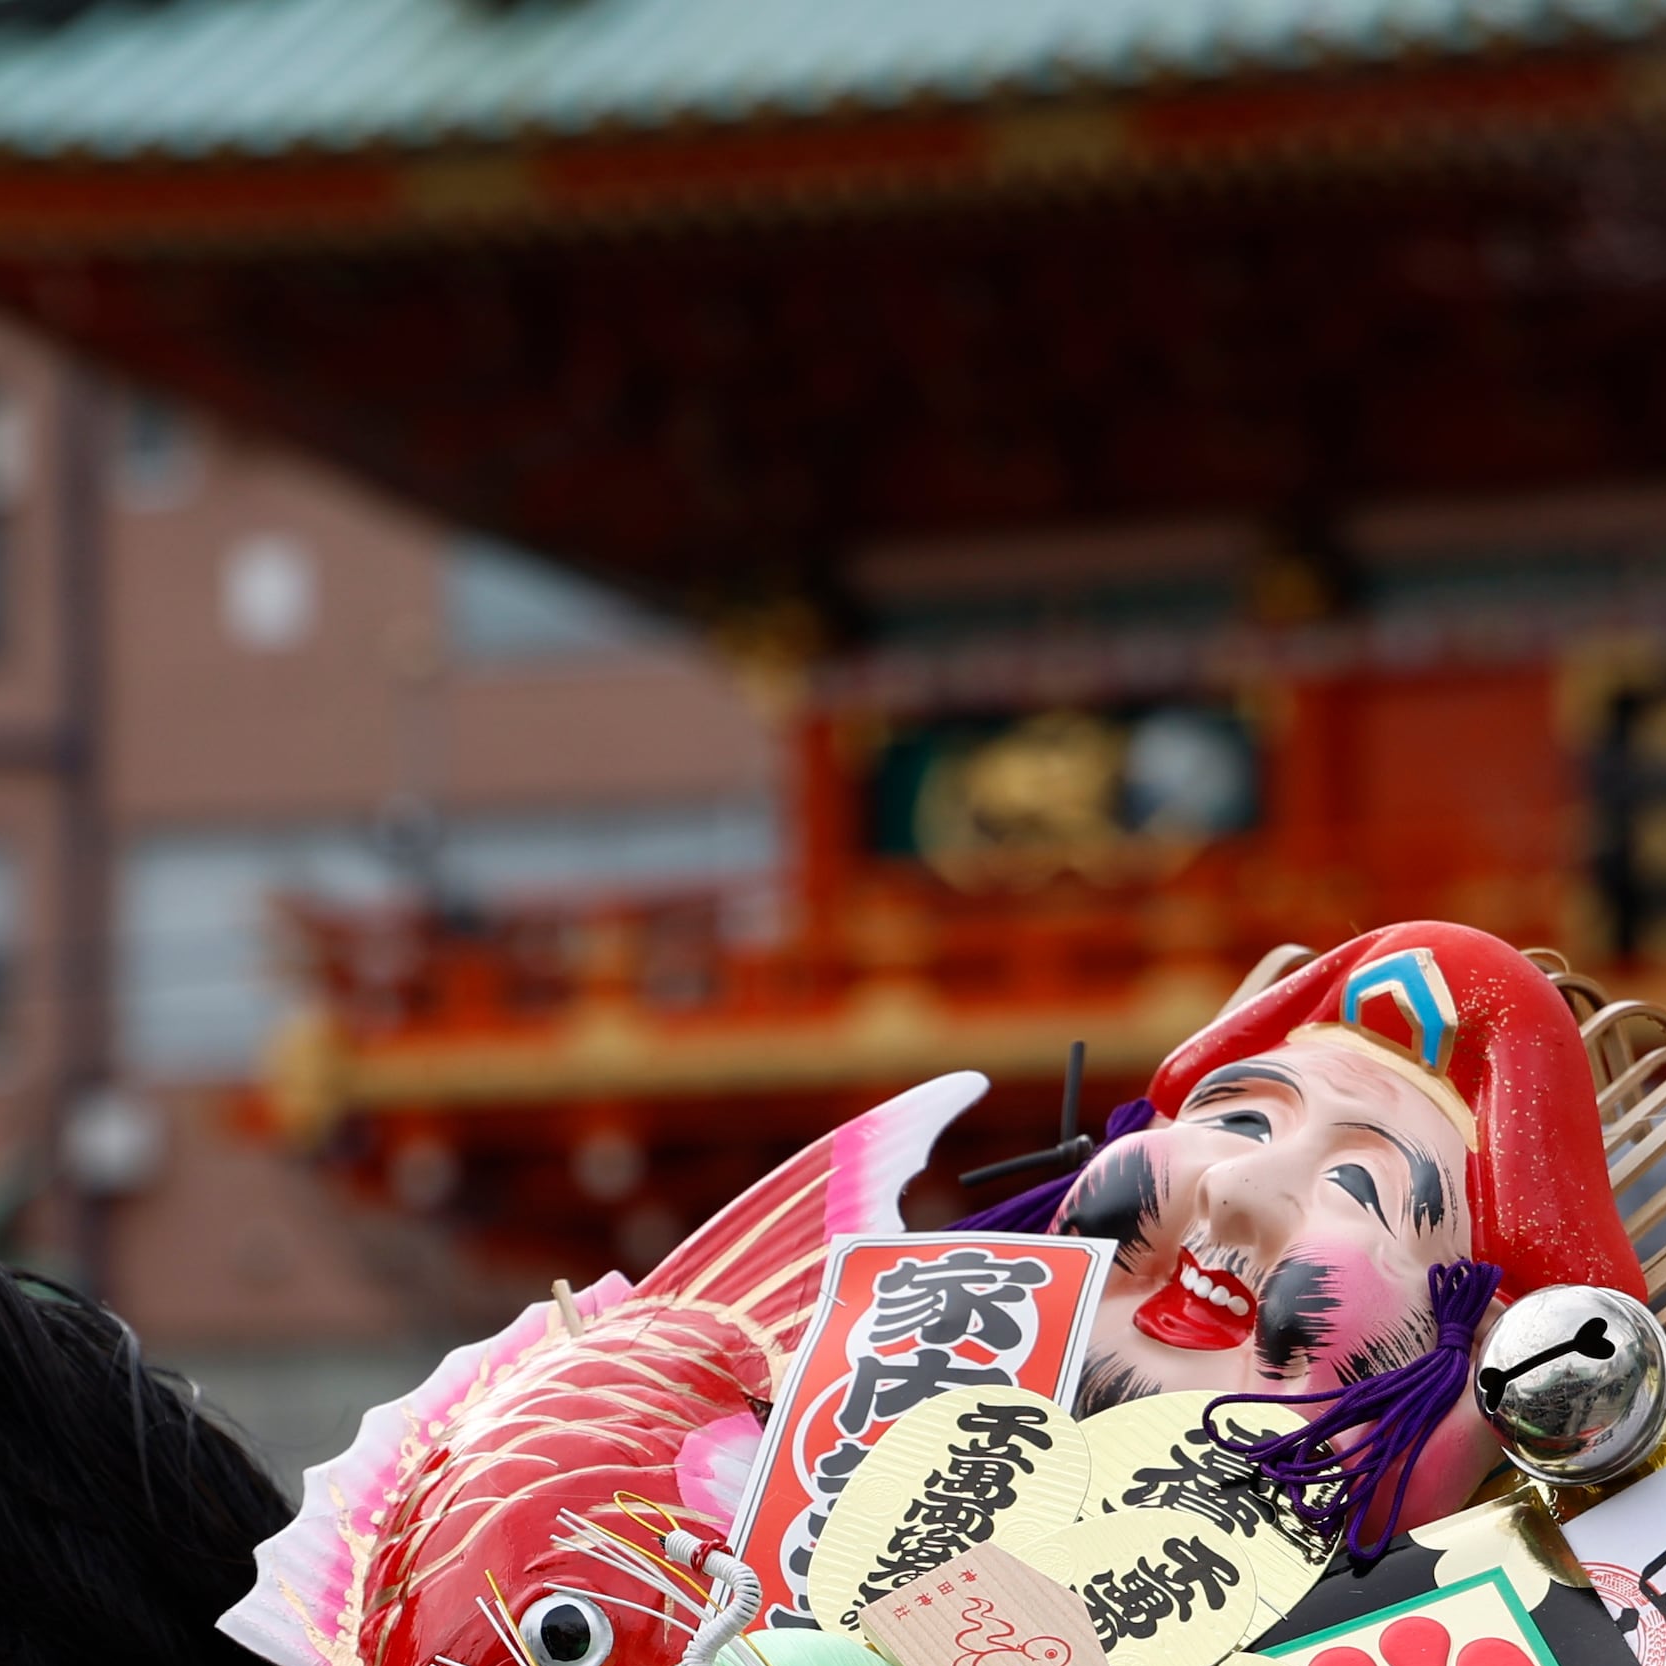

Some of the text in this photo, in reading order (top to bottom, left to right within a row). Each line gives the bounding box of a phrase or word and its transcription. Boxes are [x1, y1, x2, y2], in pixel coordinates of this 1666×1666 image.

[767, 1253, 1048, 1629] 家内
[893, 1567, 979, 1621] 神田神社
